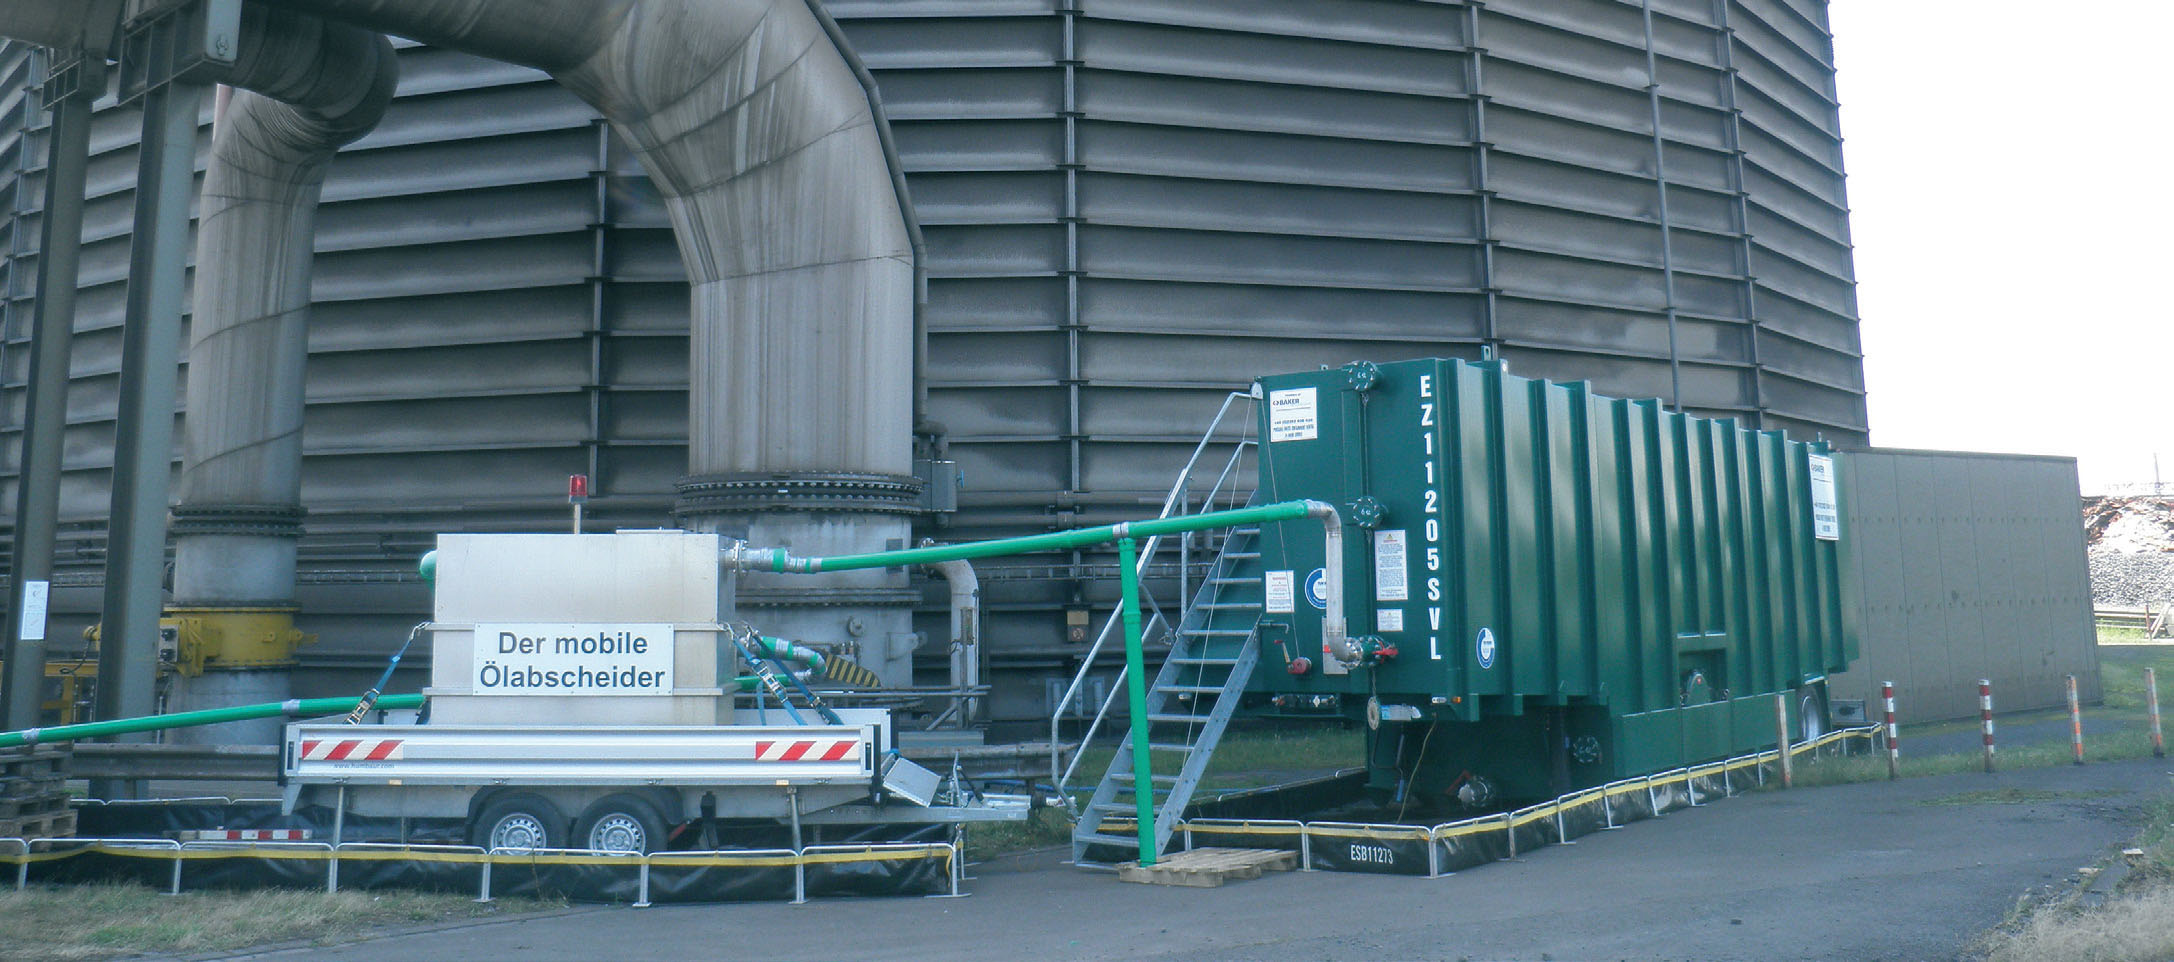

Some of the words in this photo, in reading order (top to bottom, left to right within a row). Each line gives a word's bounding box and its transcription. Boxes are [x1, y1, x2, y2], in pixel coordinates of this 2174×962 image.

[1420, 375, 1441, 660] EZ11205SVL
[499, 632, 547, 654] Der
[555, 631, 648, 654] mobile
[480, 660, 666, 687] Ölabscheider
[1350, 844, 1394, 865] ESB11273
